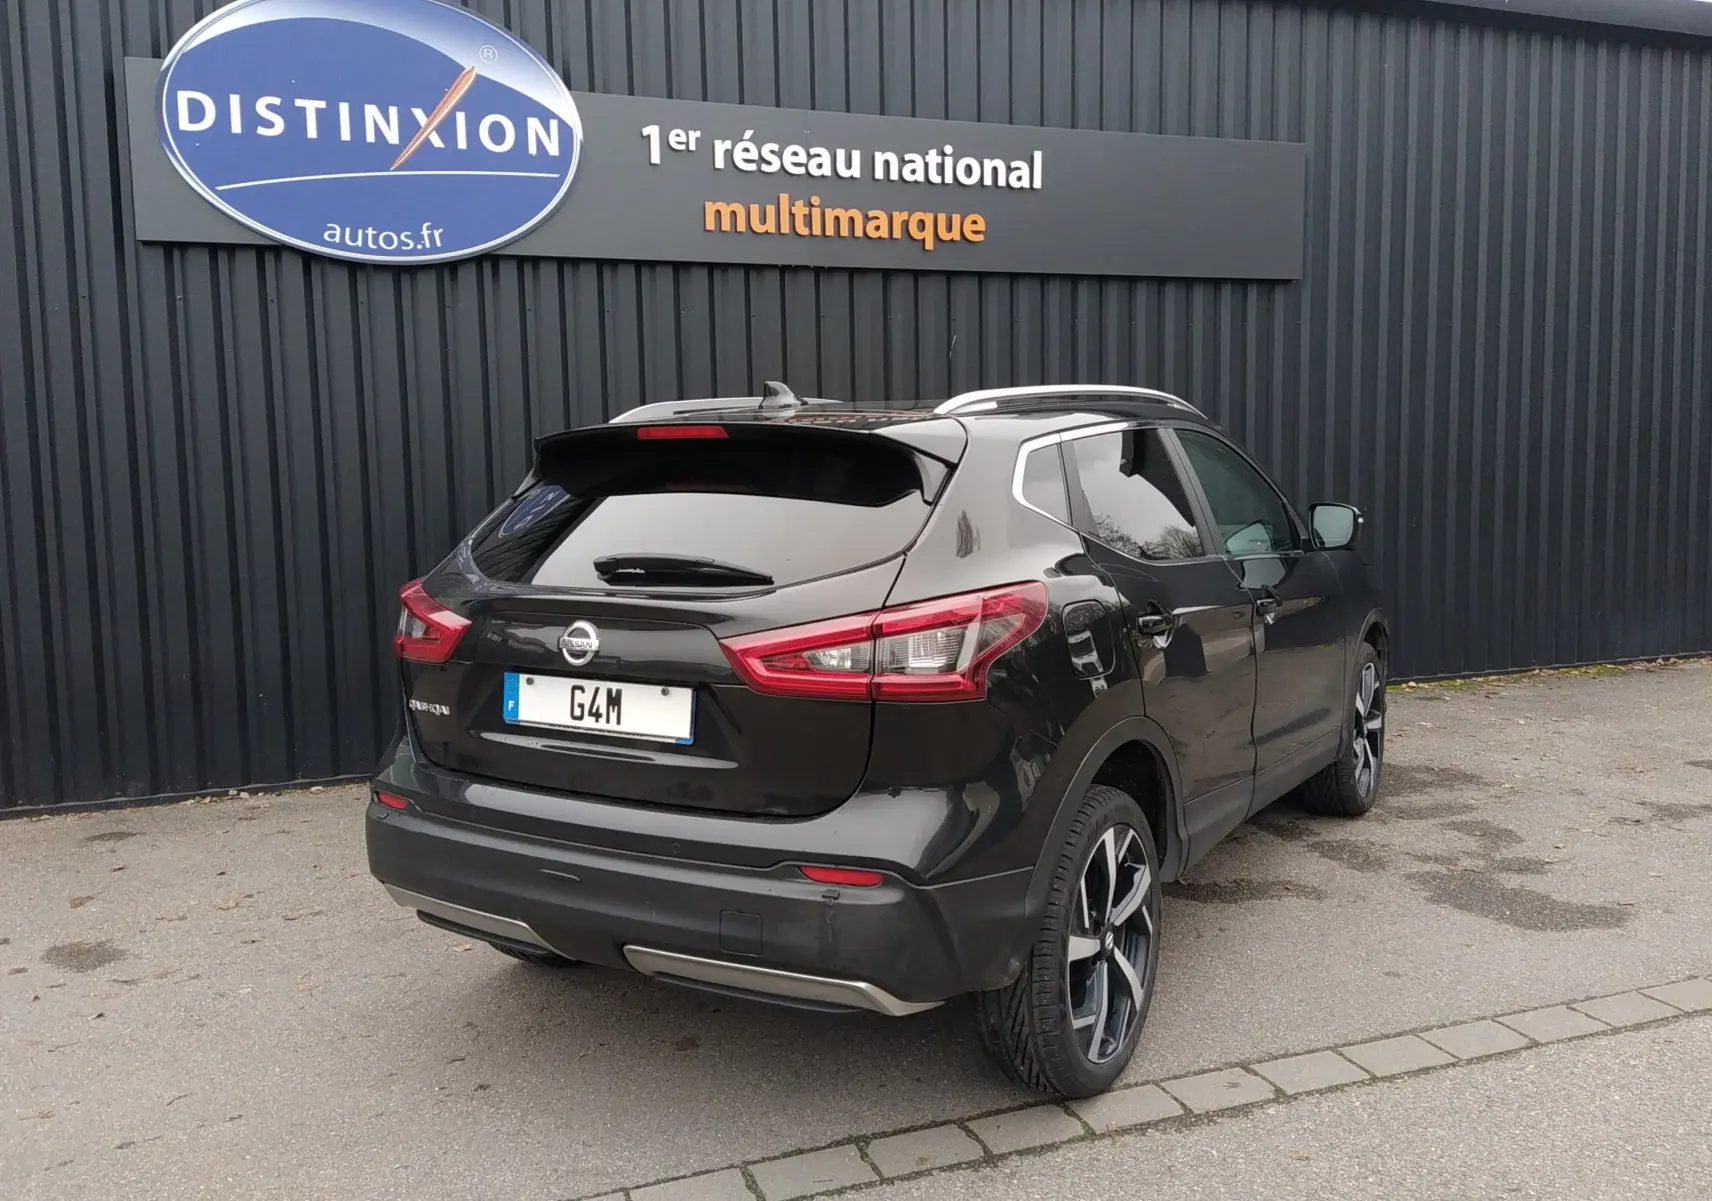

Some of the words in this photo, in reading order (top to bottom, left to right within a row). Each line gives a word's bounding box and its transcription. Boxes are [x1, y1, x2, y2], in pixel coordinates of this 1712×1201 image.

[175, 90, 561, 157] DISTINXION
[713, 129, 861, 178] réseau
[873, 145, 1043, 189] national
[323, 222, 444, 250] autos.fr
[704, 193, 986, 250] multimarque
[561, 639, 593, 649] NISSAN
[508, 699, 515, 711] F
[570, 684, 622, 726] G4M
